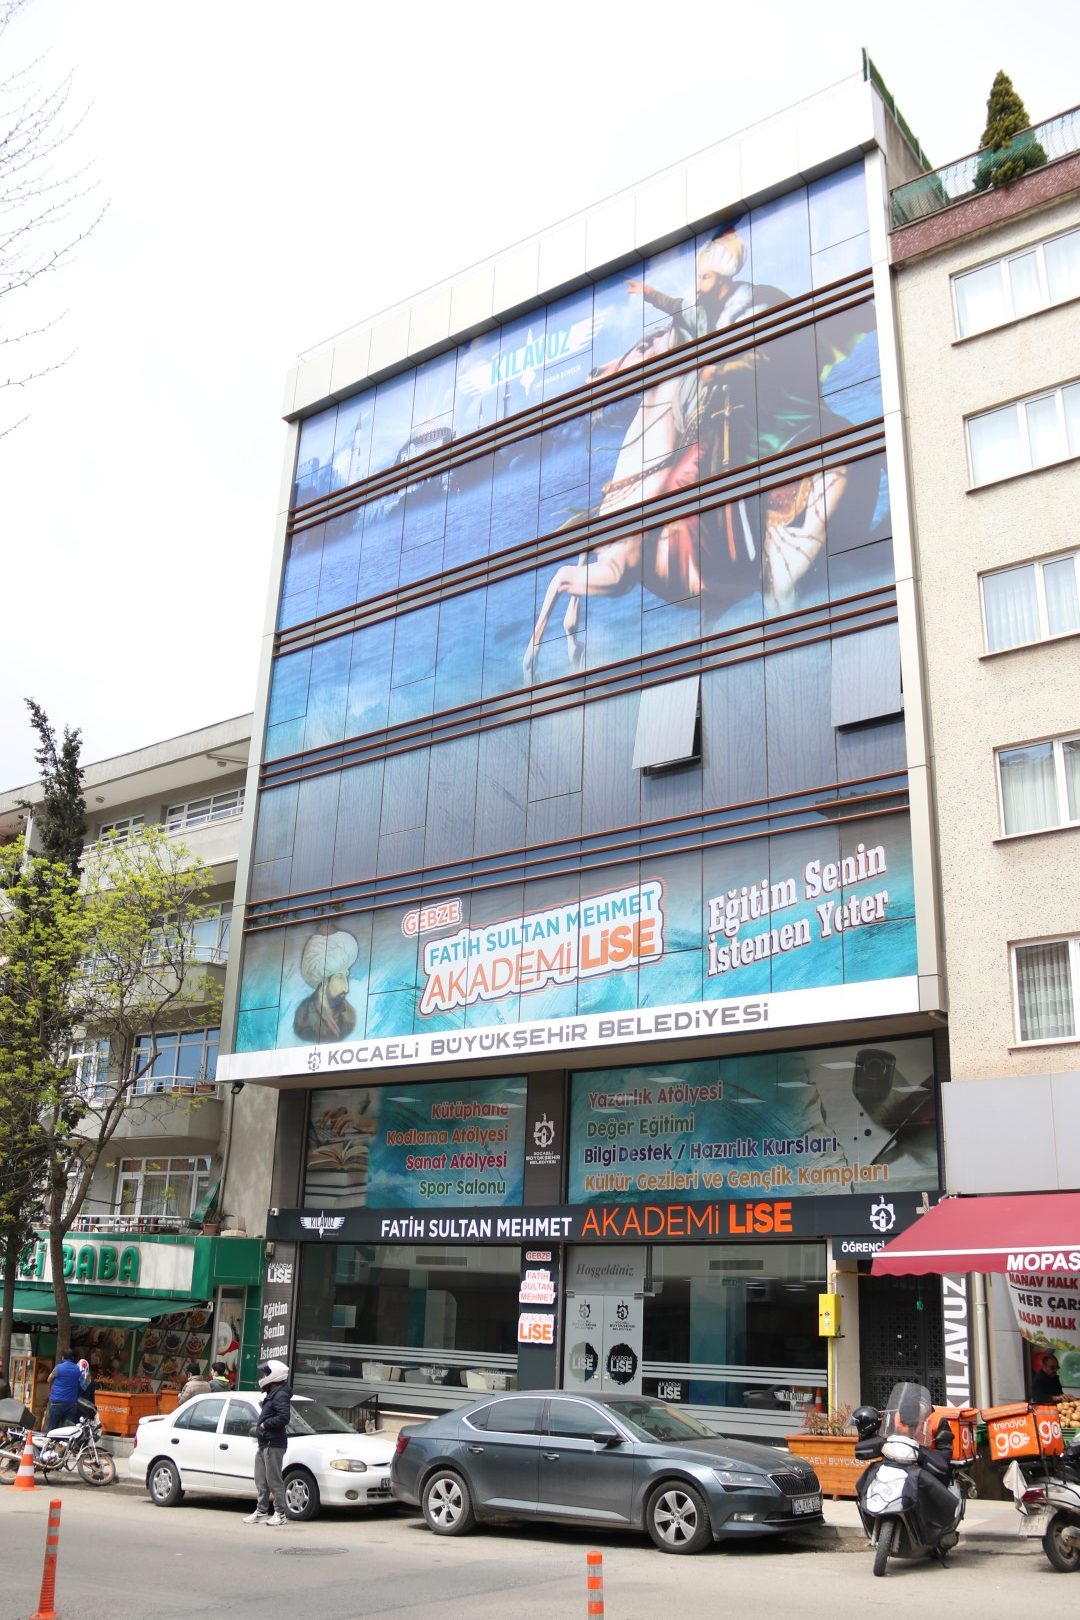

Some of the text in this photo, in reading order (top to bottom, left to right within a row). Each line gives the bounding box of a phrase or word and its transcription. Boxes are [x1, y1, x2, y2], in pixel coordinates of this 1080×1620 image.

[491, 327, 573, 385] KILAVUZ
[708, 843, 887, 937] Eğitim Senin
[404, 902, 459, 932] GEBZE
[816, 888, 889, 938] Yeter
[430, 889, 655, 967] FATİH SULTAN MEHMET
[588, 1081, 724, 1109] Yazarlık Atölyesi
[431, 1100, 510, 1120] Kütüphane
[386, 1125, 510, 1149] Kodlama Atölyesi
[586, 1113, 695, 1140] Değer Eğitimi
[406, 1151, 508, 1173] Sanat Atölyesi
[584, 1136, 838, 1167] Bilgi Destek / Hazırlık Kursları
[419, 1179, 506, 1199] Spor Salonu
[584, 1163, 890, 1193] Kültür Gezileri ve Gençlik Kampları
[381, 1215, 425, 1238] FATİH
[428, 1218, 492, 1238] SULTAN
[496, 1217, 573, 1238] MEHMET
[526, 1251, 551, 1260] GEBZE
[576, 1263, 635, 1278] Hoşgeldiniz
[1009, 1271, 1079, 1290] MANAV HALK
[522, 1282, 552, 1291] SULTAN
[1017, 1292, 1043, 1308] HER
[263, 1302, 288, 1322] Eğitim
[1046, 1316, 1077, 1331] HALK
[263, 1322, 285, 1340] Senin
[993, 1417, 1027, 1431] trendyol
[1039, 1421, 1062, 1445] go
[995, 1431, 1028, 1457] go
